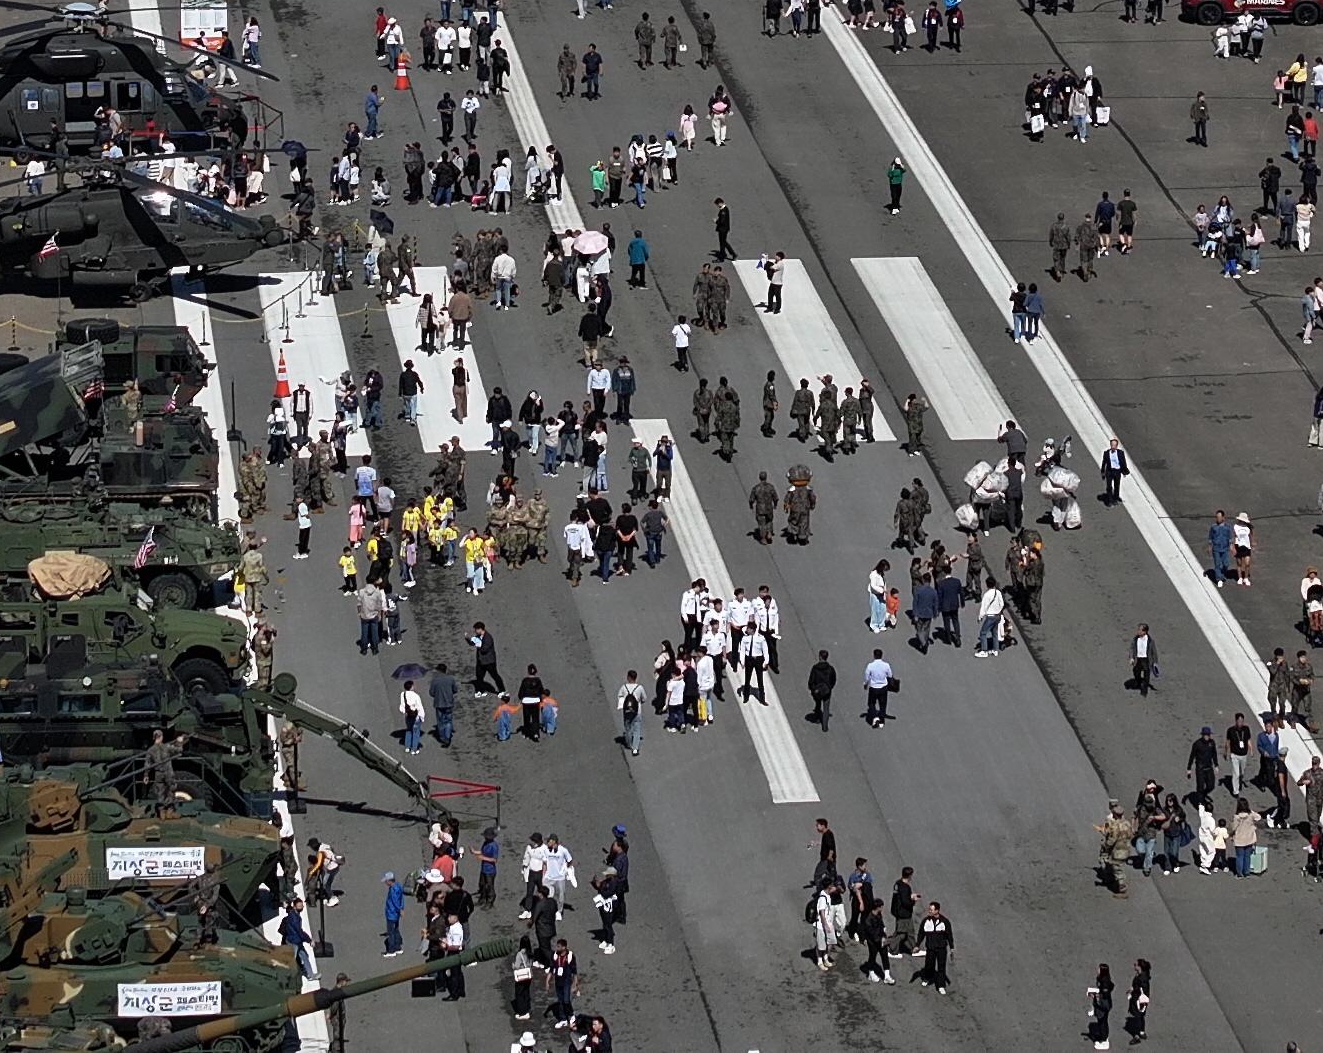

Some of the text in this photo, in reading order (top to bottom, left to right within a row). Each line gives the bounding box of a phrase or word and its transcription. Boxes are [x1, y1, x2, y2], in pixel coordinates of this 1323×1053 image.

[111, 859, 202, 876] 지상군 페스티벌
[123, 995, 219, 1013] 지상군 페스티벌
